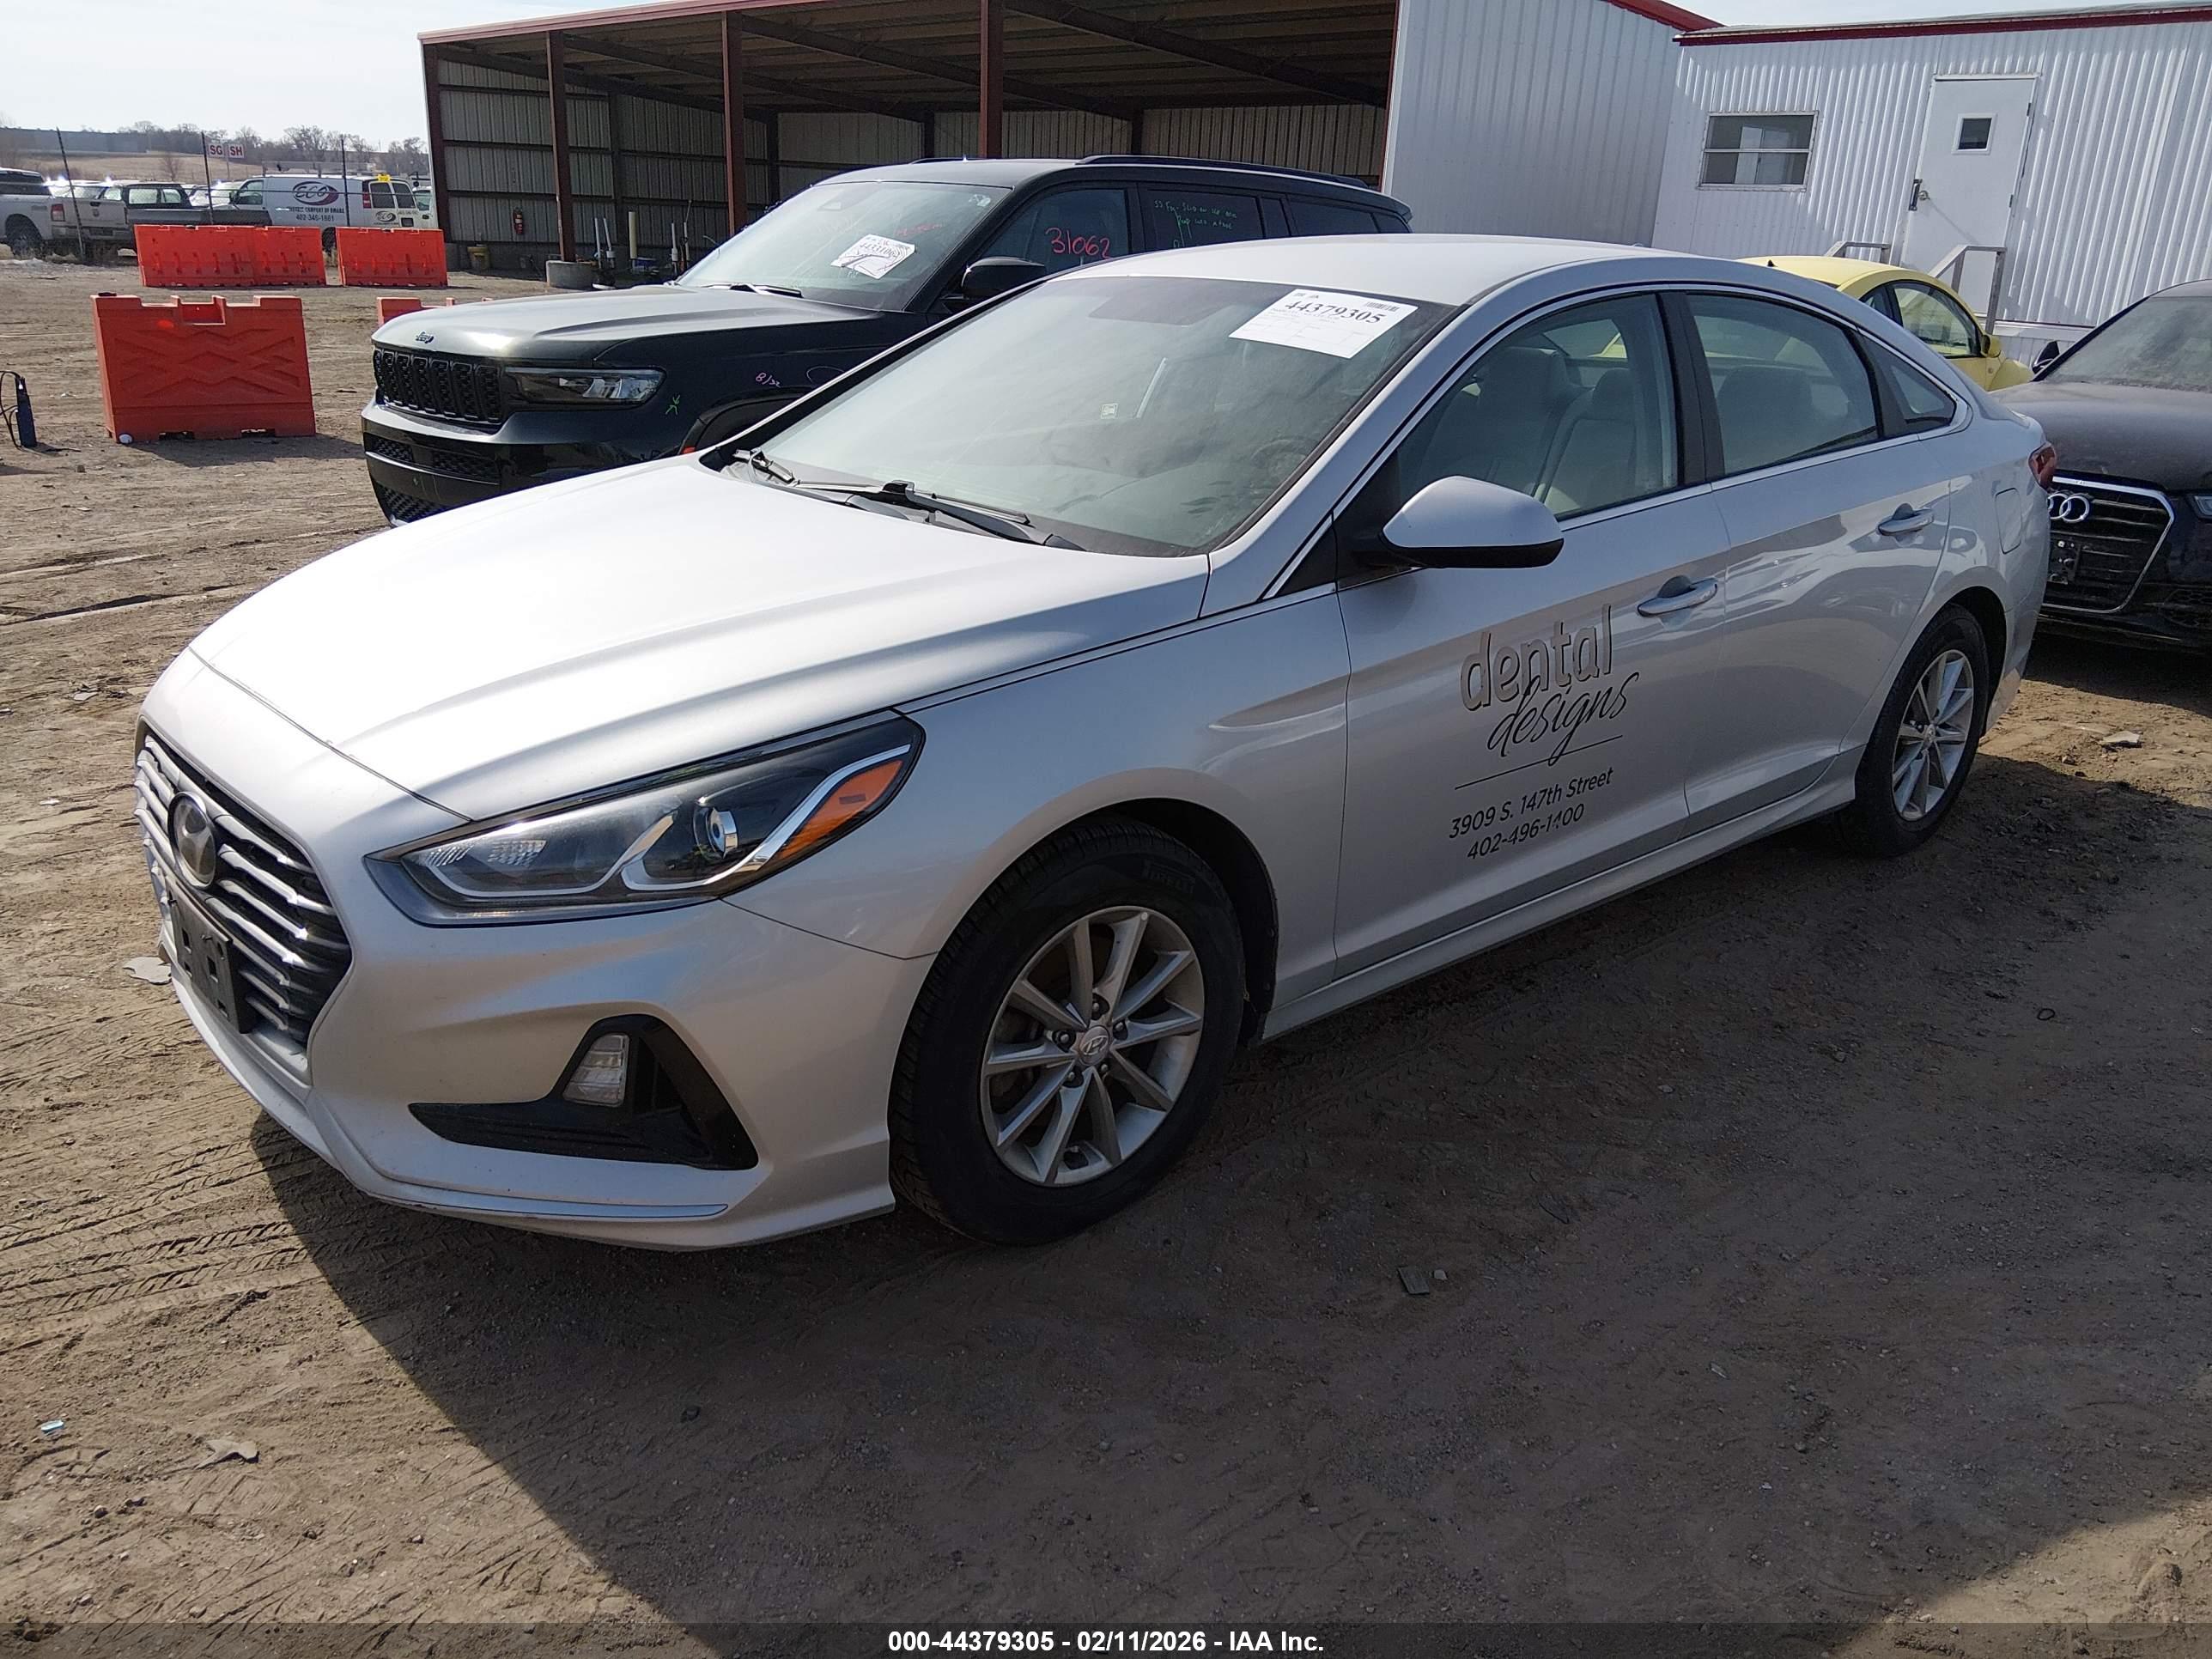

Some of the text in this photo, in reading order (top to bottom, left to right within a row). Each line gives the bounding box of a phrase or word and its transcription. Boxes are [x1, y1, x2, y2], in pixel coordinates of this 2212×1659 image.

[210, 144, 223, 155] SG
[229, 145, 243, 156] SH
[1045, 228, 1114, 260] 31062
[1285, 300, 1387, 324] 44379305
[1460, 603, 1613, 712] dental
[1486, 672, 1640, 767] designs
[1449, 767, 1614, 840] 3909 S. 147th Street
[1467, 803, 1585, 860] 402-496-1400
